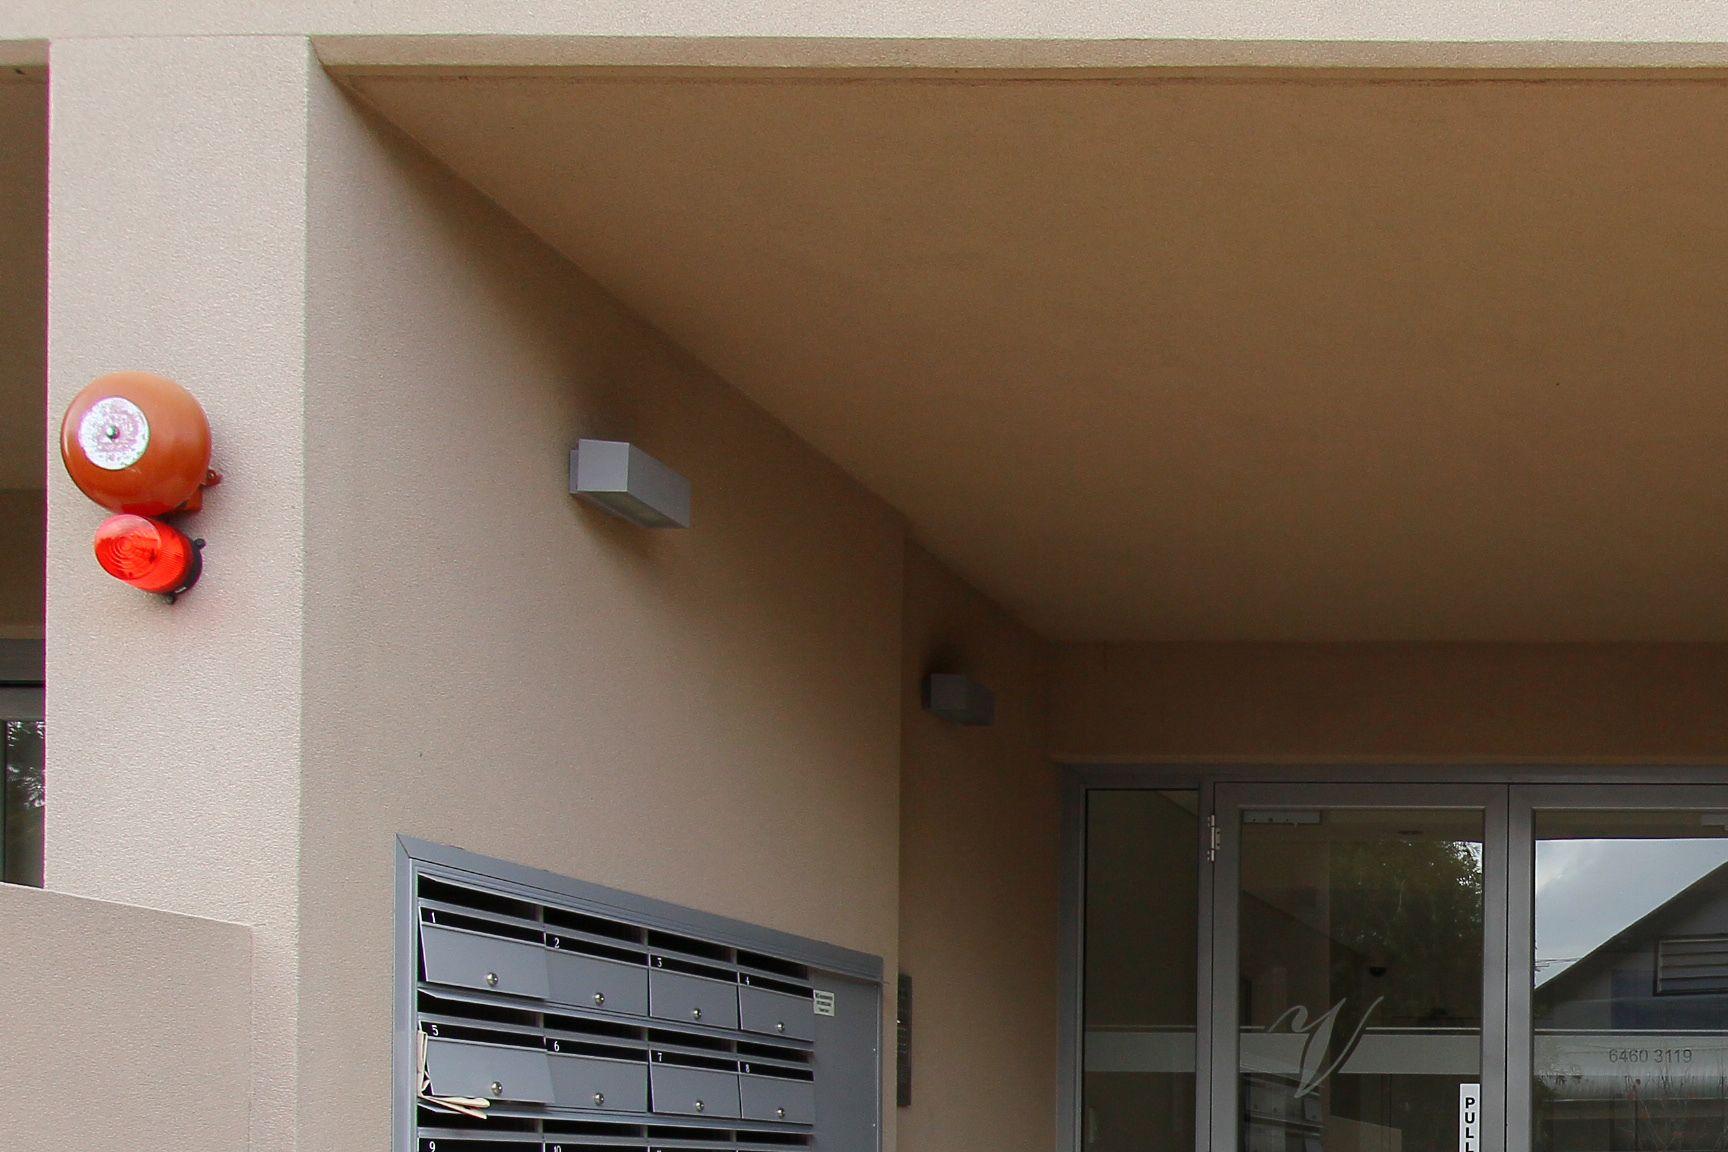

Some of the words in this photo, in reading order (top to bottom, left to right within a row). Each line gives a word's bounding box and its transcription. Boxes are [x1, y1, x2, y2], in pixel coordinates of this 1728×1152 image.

[554, 937, 560, 949] 2
[657, 957, 663, 968] 3
[432, 1024, 439, 1037] 5
[553, 1041, 560, 1052] 6
[657, 1052, 663, 1063] 7
[1608, 1048, 1649, 1063] 6460
[1654, 1048, 1693, 1063] 3119
[745, 1063, 750, 1073] 8
[429, 1141, 436, 1152] 9
